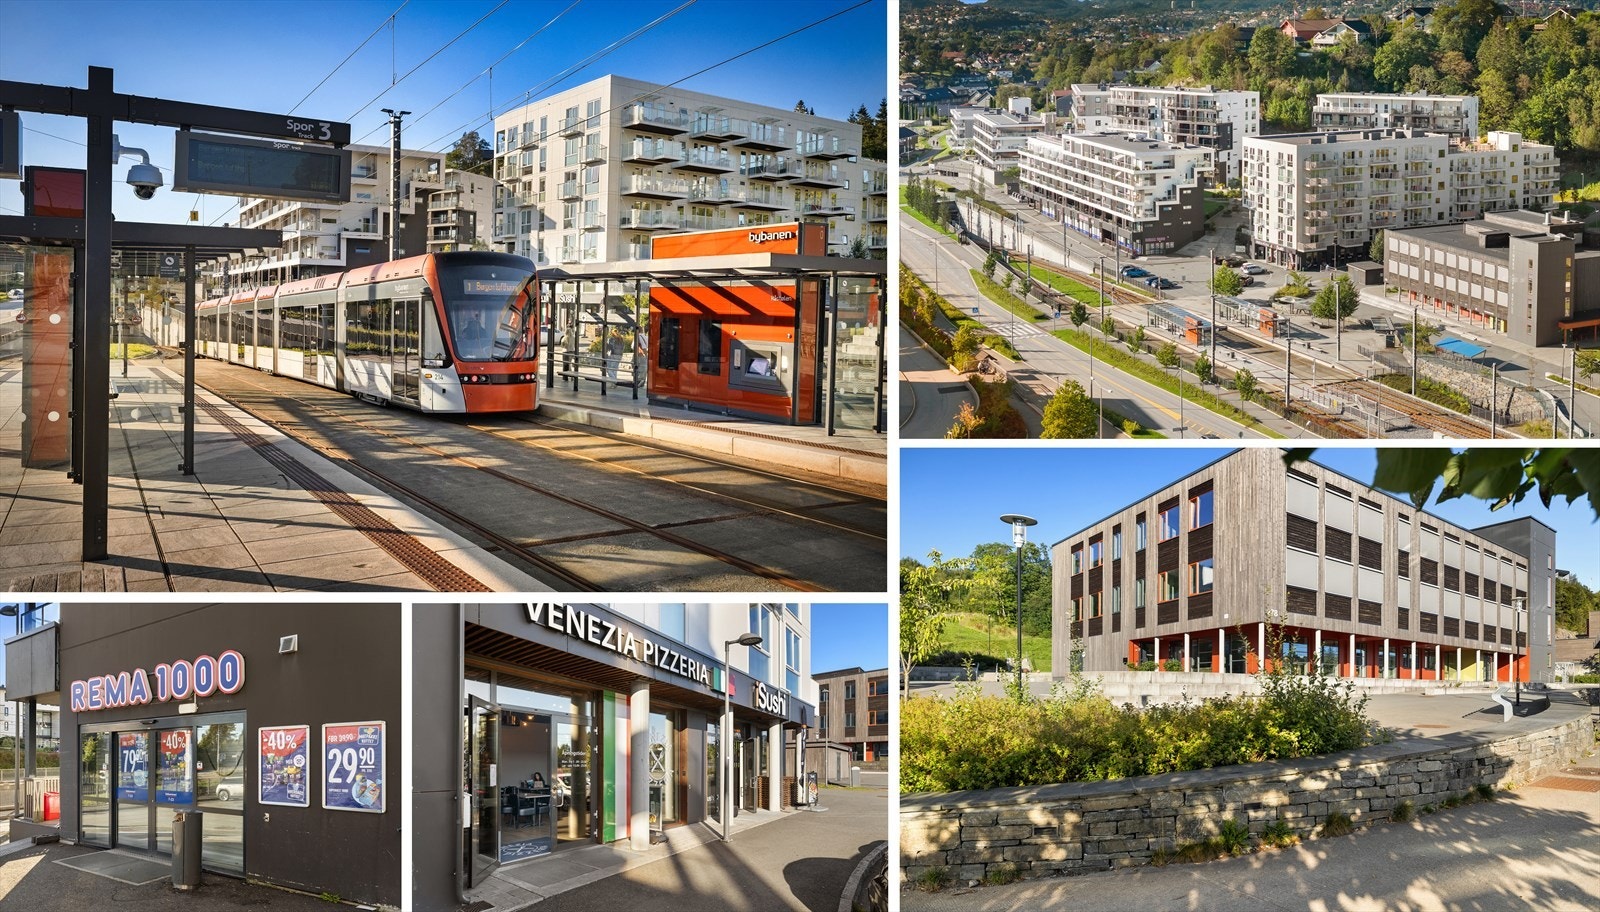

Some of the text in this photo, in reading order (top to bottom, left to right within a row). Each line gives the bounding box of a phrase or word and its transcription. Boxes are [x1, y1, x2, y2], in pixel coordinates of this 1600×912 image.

[286, 119, 332, 140] Spor 3
[273, 141, 290, 149] Spor
[748, 231, 792, 244] bybanen
[526, 603, 709, 684] VENEZIA PIZZERIA
[71, 650, 245, 712] REMA 1000
[754, 680, 786, 716] iSushi
[163, 732, 186, 749] -40%
[263, 731, 297, 750] -40%
[328, 747, 375, 784] 29 90
